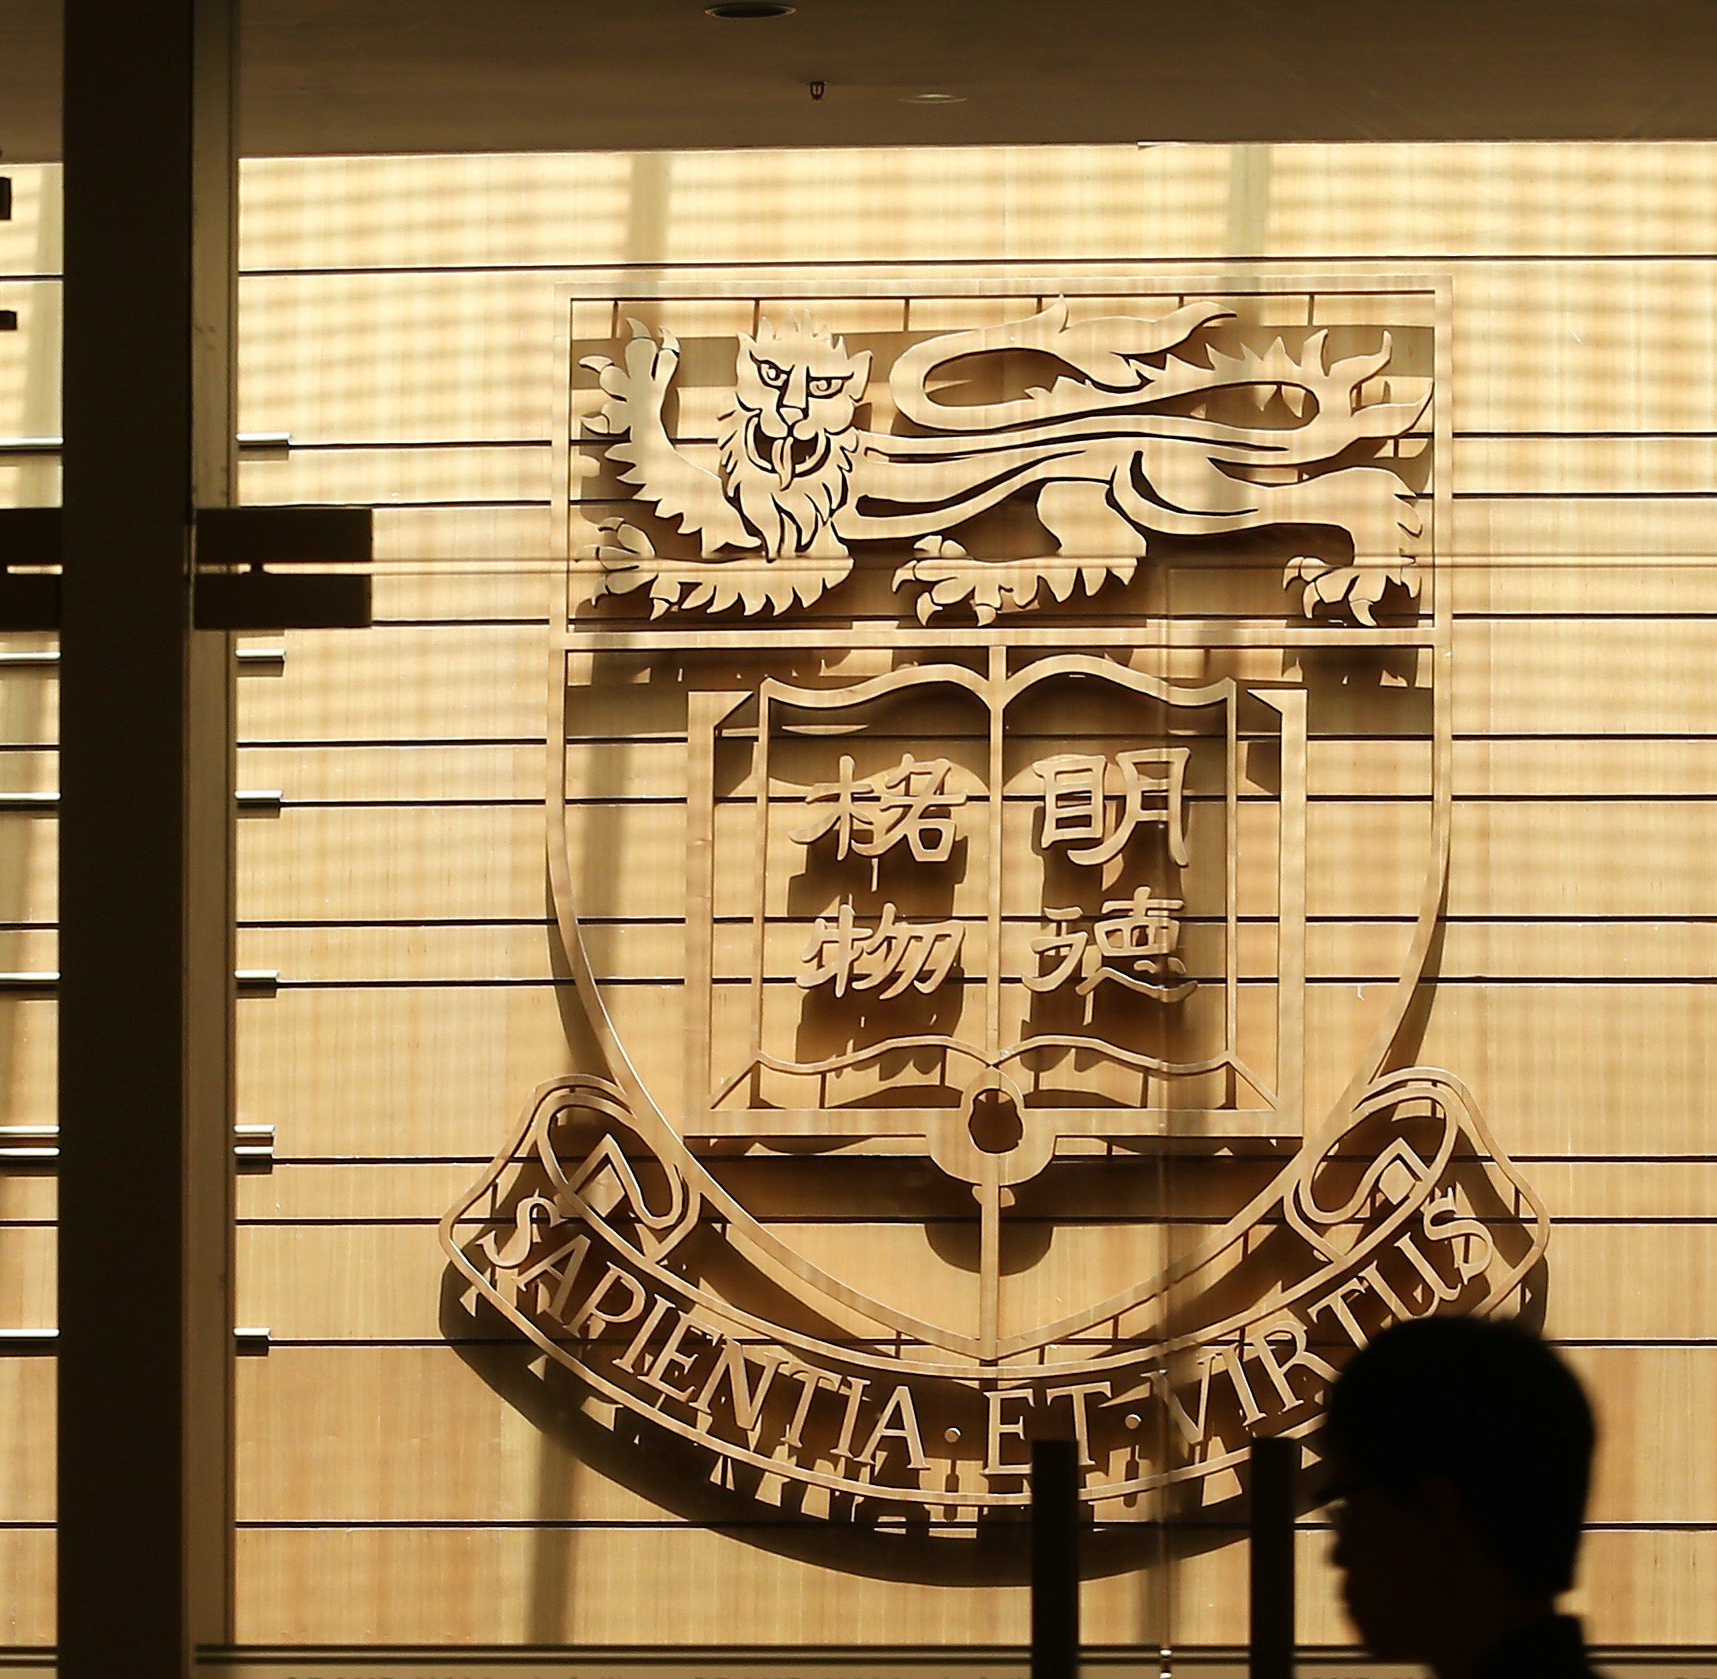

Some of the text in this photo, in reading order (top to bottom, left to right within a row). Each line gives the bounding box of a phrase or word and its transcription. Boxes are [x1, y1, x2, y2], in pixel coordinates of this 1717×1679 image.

[474, 1186, 1493, 1475] SAPIENTIA ET VIRTUS
